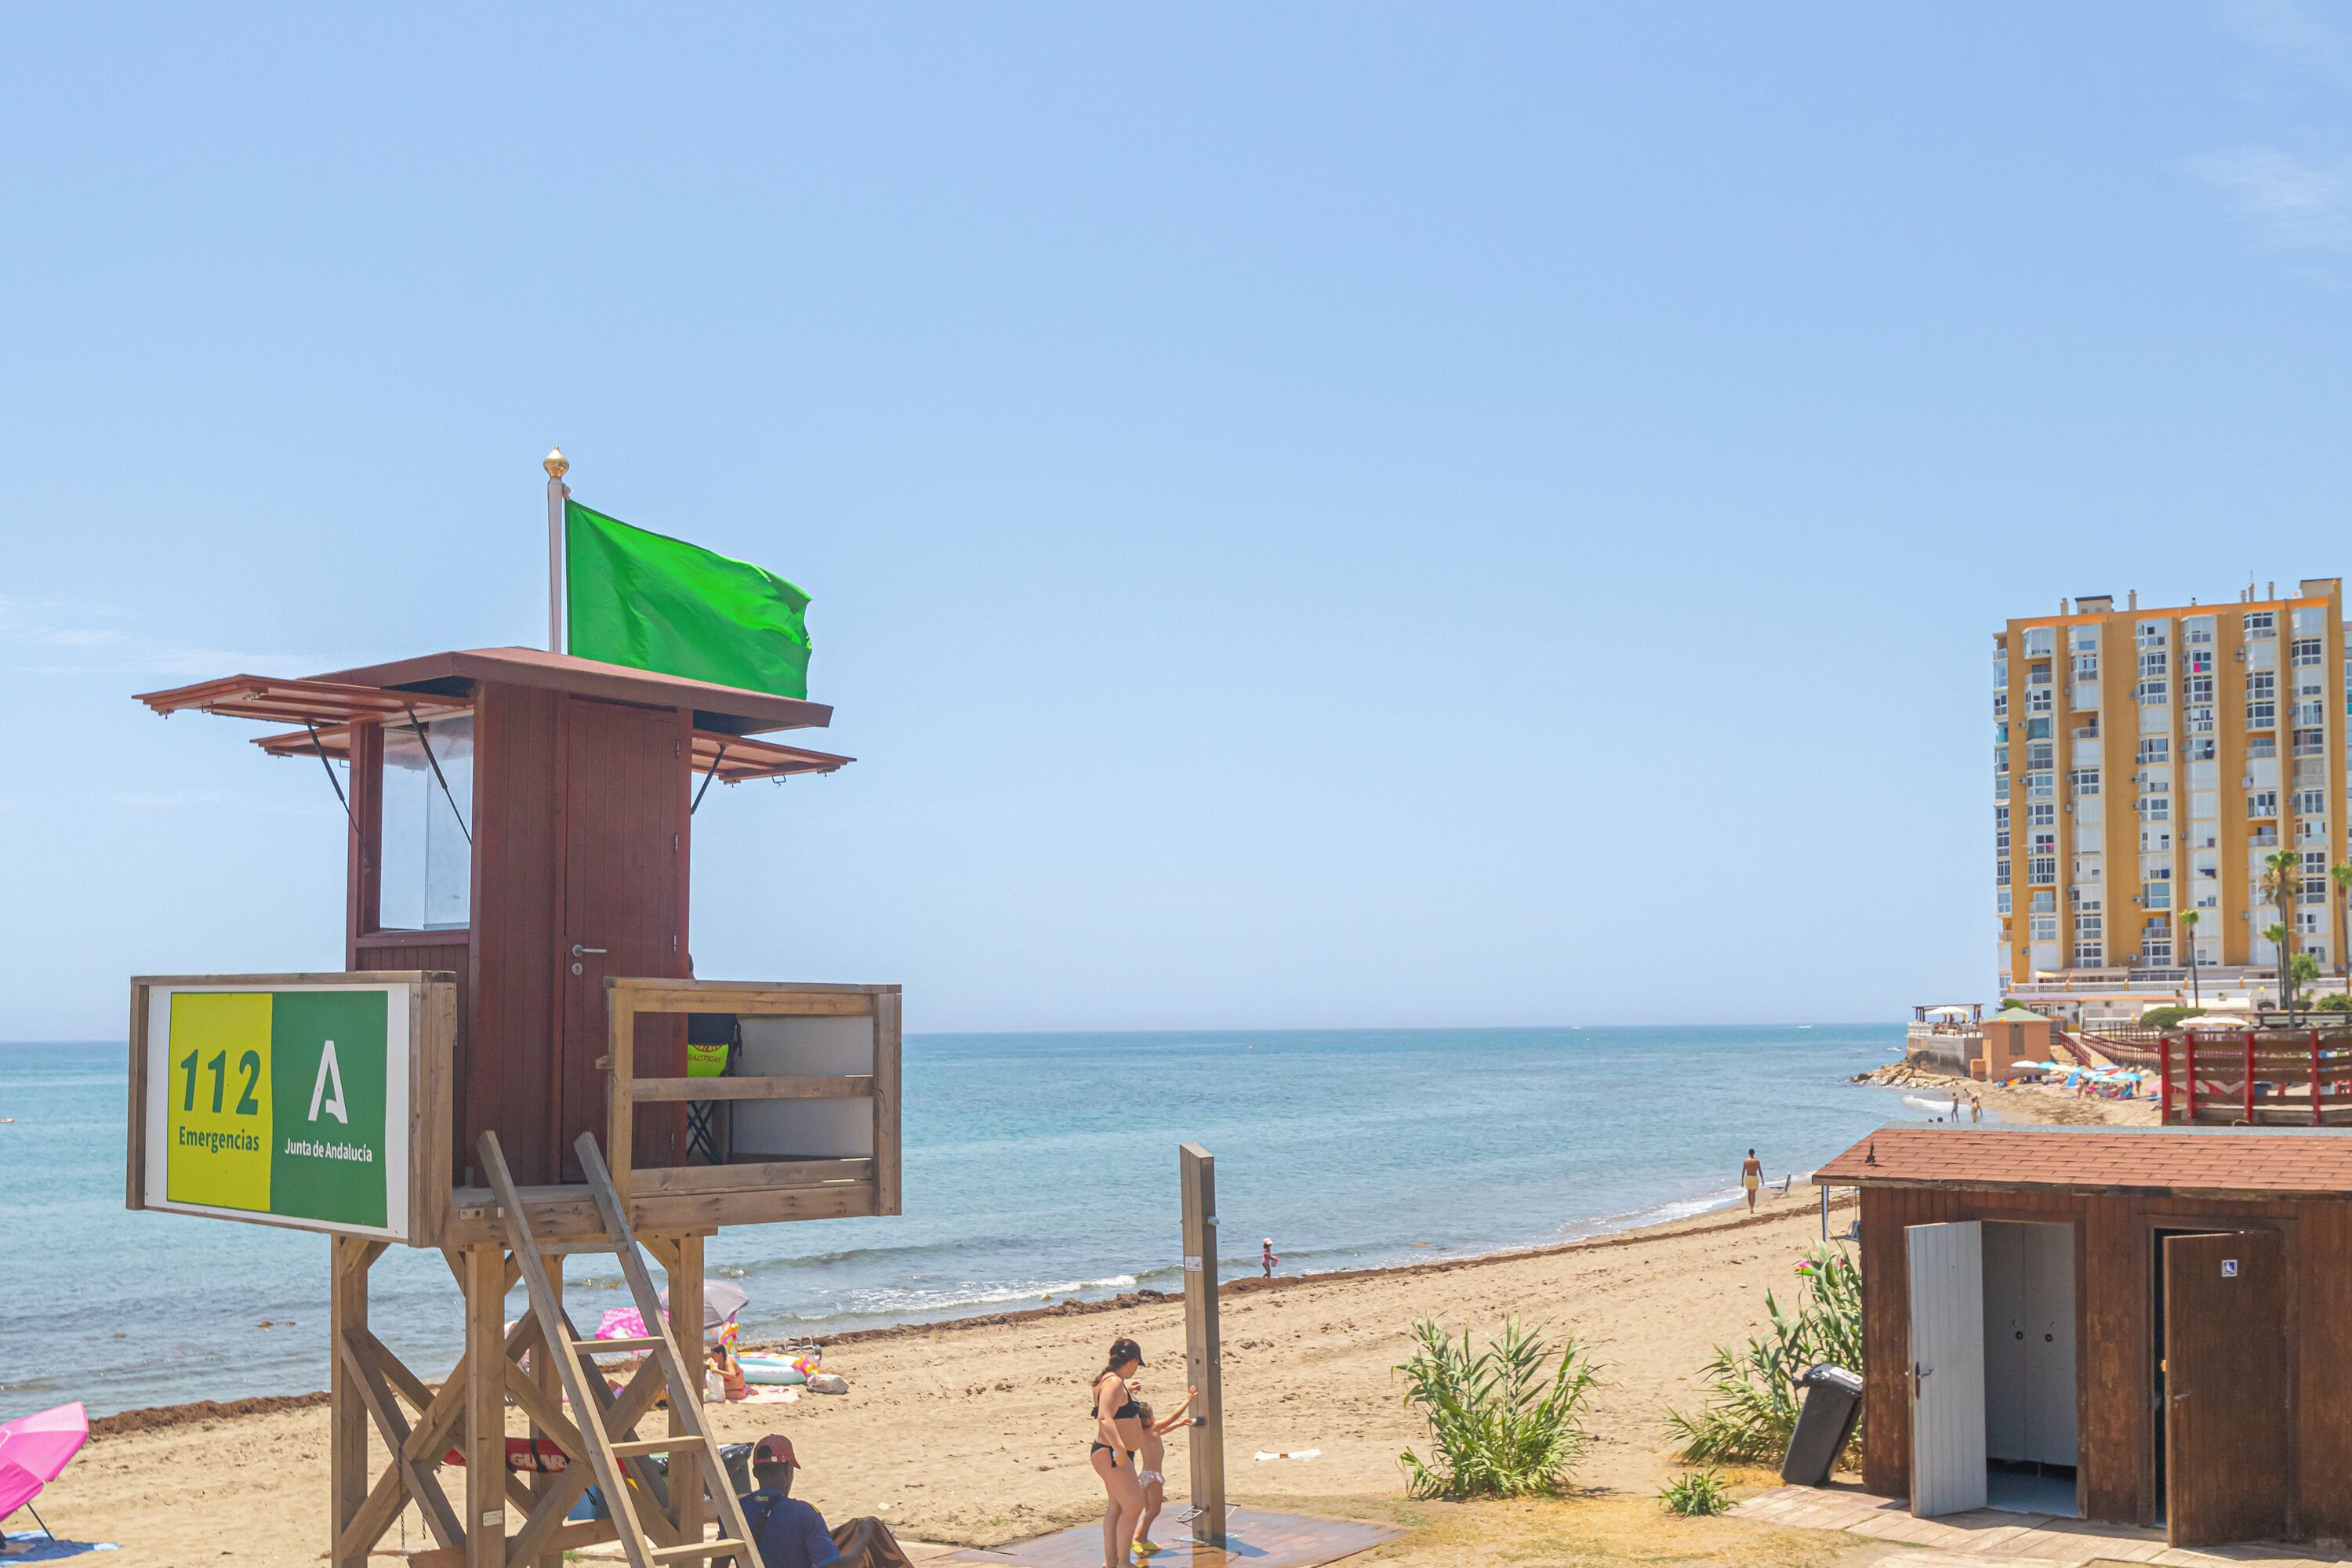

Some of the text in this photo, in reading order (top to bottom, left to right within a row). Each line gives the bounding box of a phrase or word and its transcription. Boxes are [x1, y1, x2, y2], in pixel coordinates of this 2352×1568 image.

[180, 1049, 260, 1116] 112
[179, 1126, 260, 1154] Emergencias
[285, 1138, 372, 1163] Junta de Andalucía
